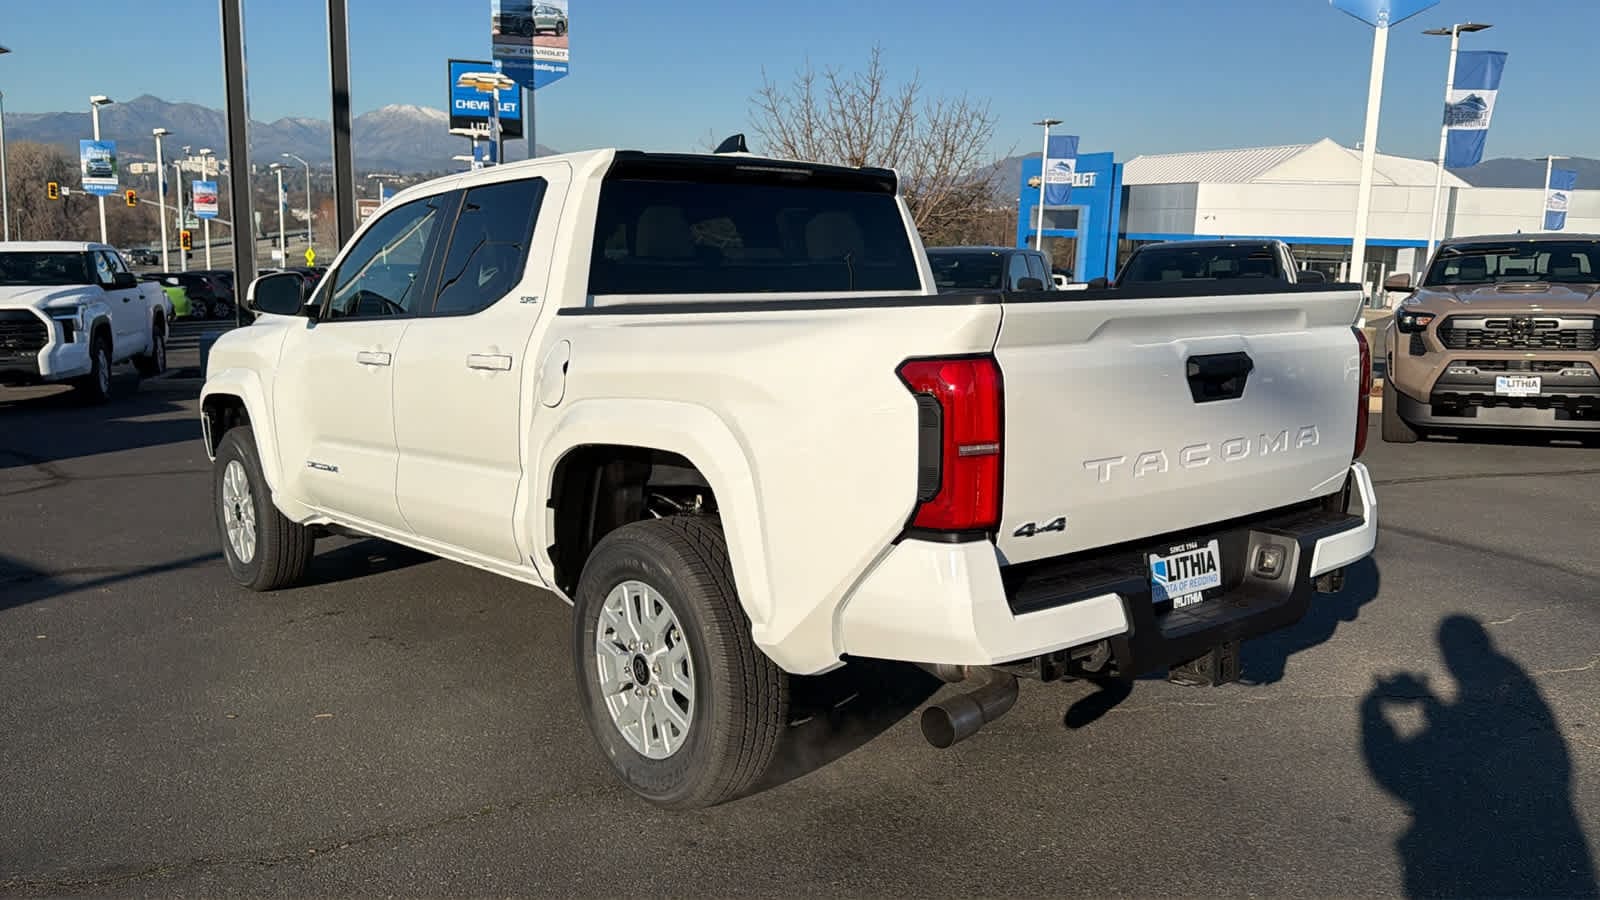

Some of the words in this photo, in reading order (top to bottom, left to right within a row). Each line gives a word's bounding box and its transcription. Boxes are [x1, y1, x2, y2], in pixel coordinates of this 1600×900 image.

[455, 99, 516, 112] CHEVRLET
[1507, 380, 1537, 388] LITHIA
[1082, 424, 1321, 483] TACOMA
[1170, 544, 1185, 553] SINCE
[1166, 550, 1217, 583] LITHIA
[1179, 581, 1189, 590] OF
[1189, 574, 1218, 588] REDDING
